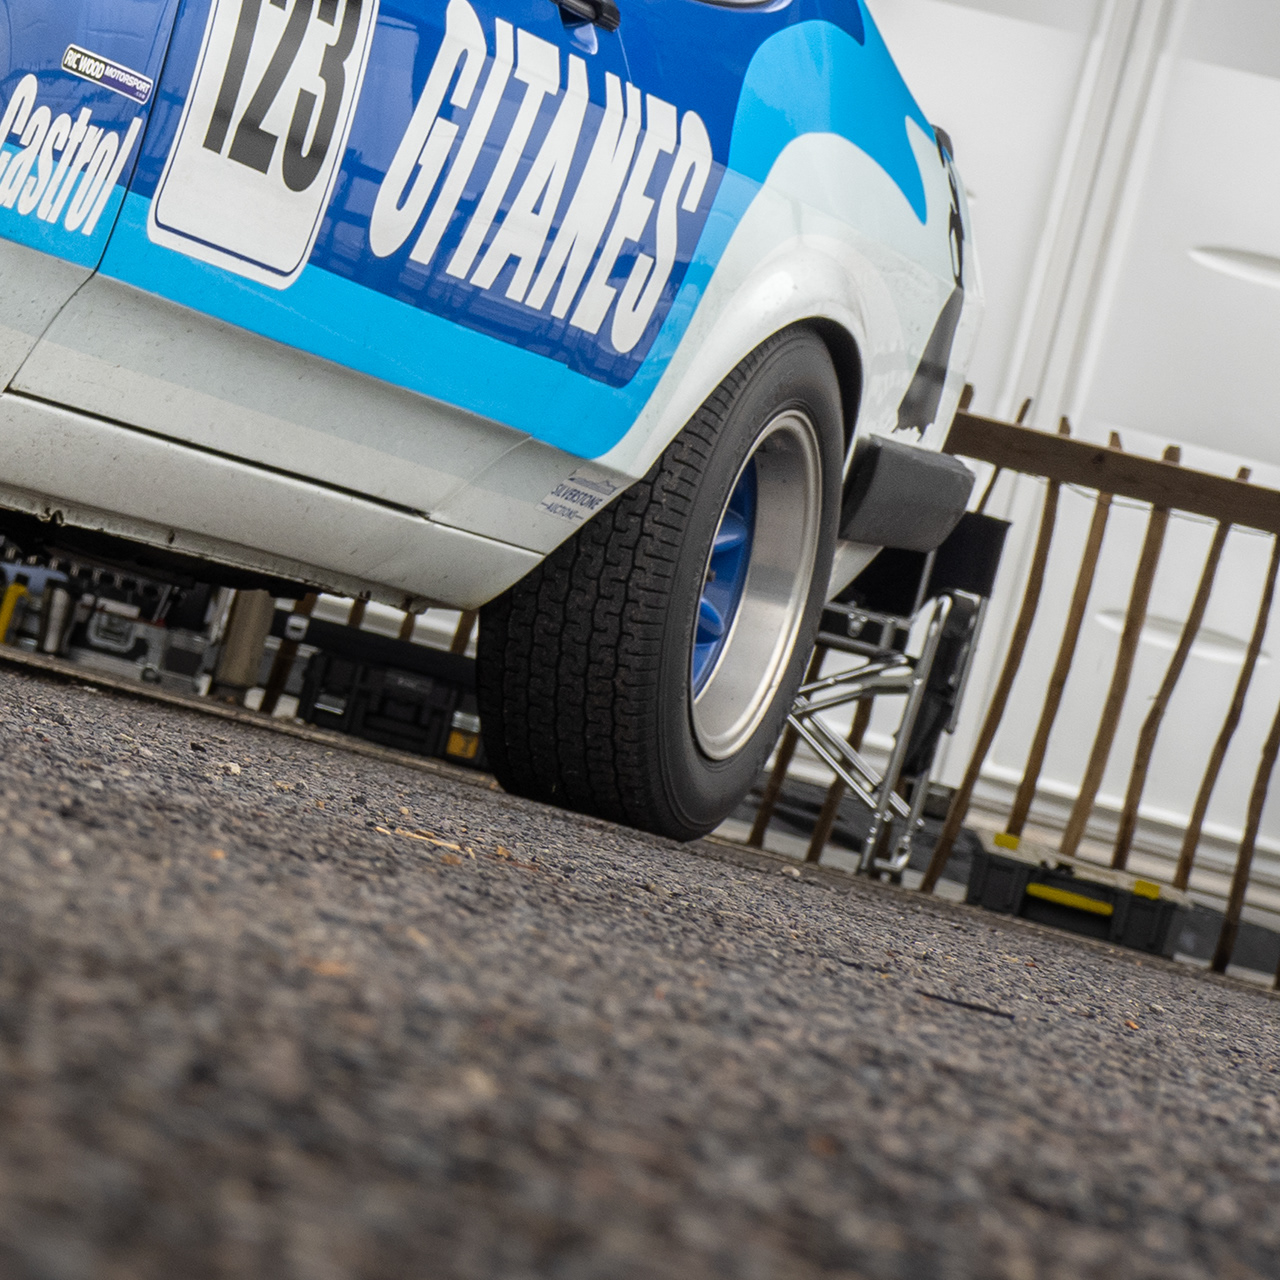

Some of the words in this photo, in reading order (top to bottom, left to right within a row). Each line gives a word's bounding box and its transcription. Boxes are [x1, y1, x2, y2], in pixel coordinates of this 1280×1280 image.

[64, 49, 82, 70] RIC
[78, 55, 106, 79] WOOD
[104, 65, 151, 94] MOTORSPORT
